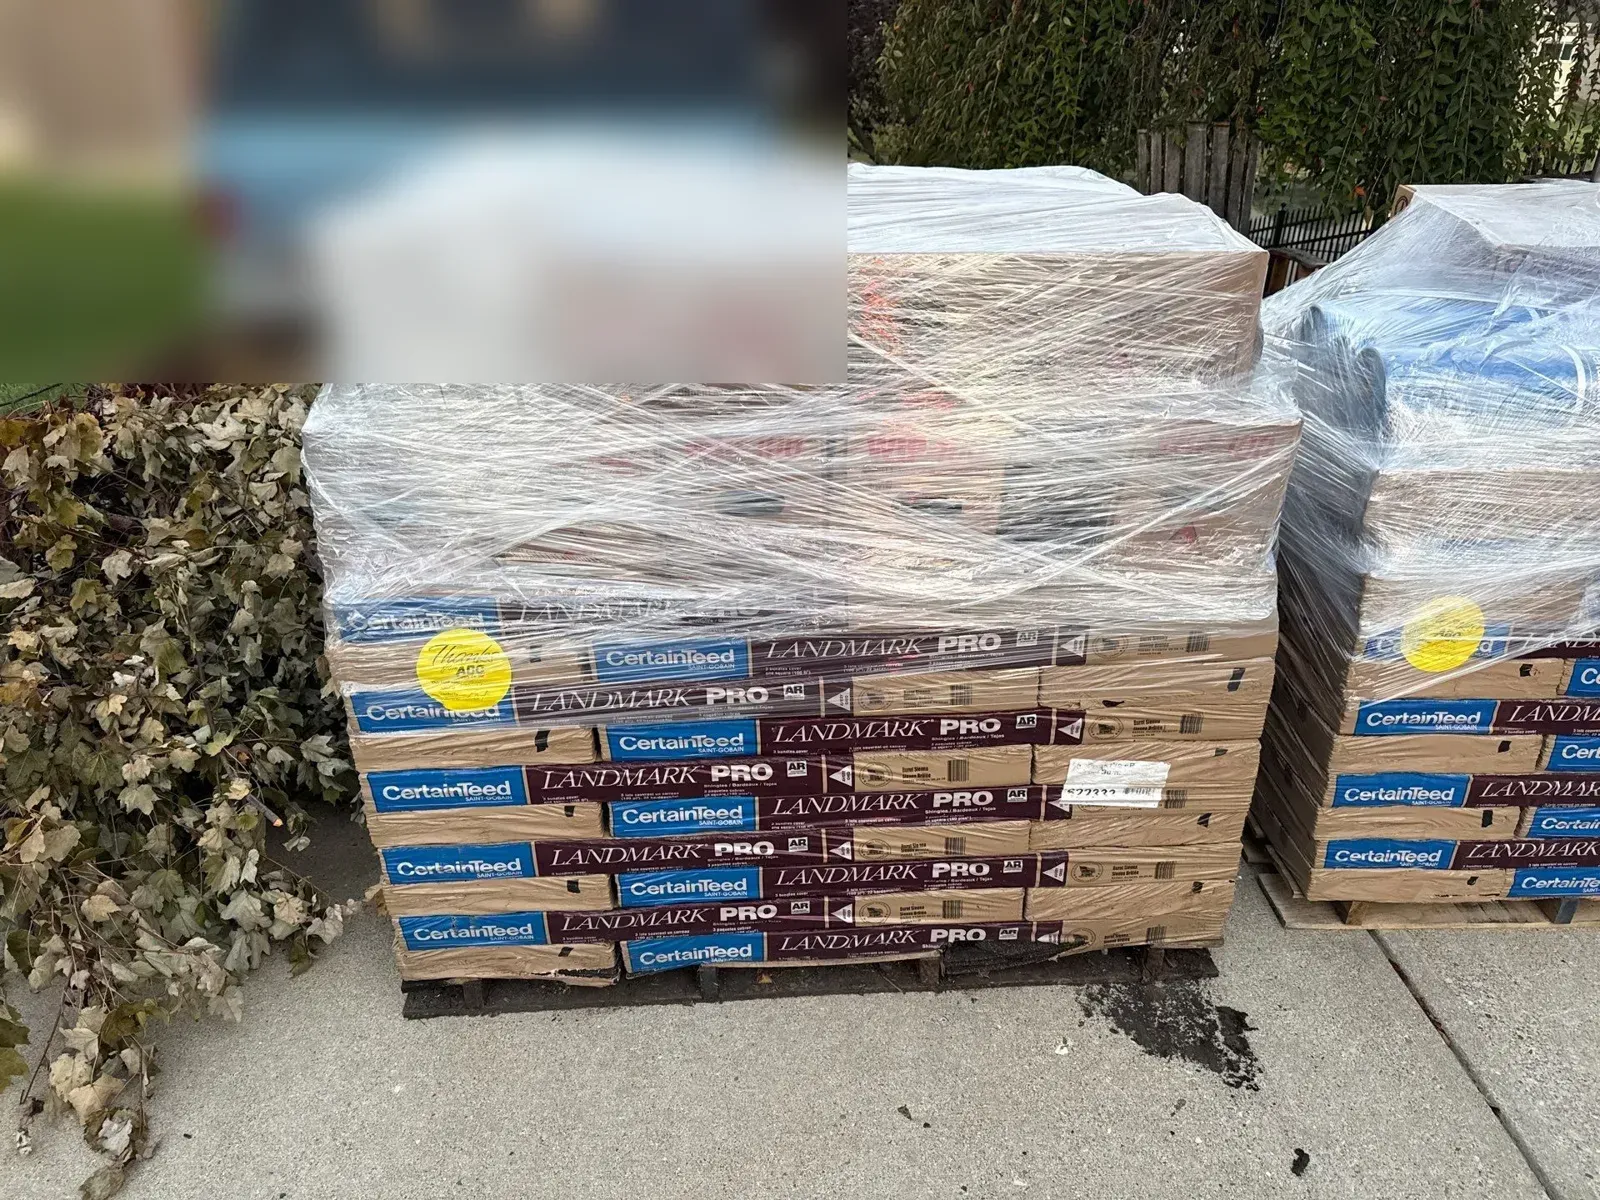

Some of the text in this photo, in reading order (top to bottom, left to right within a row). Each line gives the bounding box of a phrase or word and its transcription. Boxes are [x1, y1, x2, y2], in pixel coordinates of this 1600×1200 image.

[1018, 631, 1037, 641] AR
[766, 632, 1002, 659] LANDMARK PRO
[606, 649, 735, 666] CertainTeed
[688, 663, 735, 671] SAINT-GOBAIN
[786, 684, 804, 694] AR
[532, 686, 769, 712] LANDMARK PRO
[1018, 716, 1036, 726] AR
[1367, 711, 1480, 728] CertainTeed
[773, 718, 1002, 742] LANDMARK PRO
[619, 733, 744, 751] CertainTeed
[788, 762, 806, 771] AR
[541, 763, 773, 790] LANDMARK PRO
[382, 780, 512, 800] CertainTeed
[1008, 789, 1026, 798] AR
[1344, 786, 1454, 801] CertainTeed
[771, 791, 994, 815] LANDMARK PRO
[622, 806, 743, 824] CertainTeed
[790, 838, 807, 847] AR
[1466, 842, 1598, 859] LANDMARK
[550, 841, 775, 866] LANDMARK PRO
[1335, 849, 1443, 863] CertainTeed
[397, 858, 522, 876] CertainTeed
[1005, 860, 1023, 869] AR
[775, 864, 920, 886] LANDMARK
[932, 863, 990, 878] PRO
[630, 878, 747, 895] CertainTeed
[792, 903, 809, 911] AR
[562, 905, 778, 932] LANDMARK PRO
[414, 924, 533, 941] CertainTeed
[779, 929, 987, 951] LANDMARK PRO
[999, 928, 1018, 936] AR
[639, 944, 752, 965] CertainTeed
